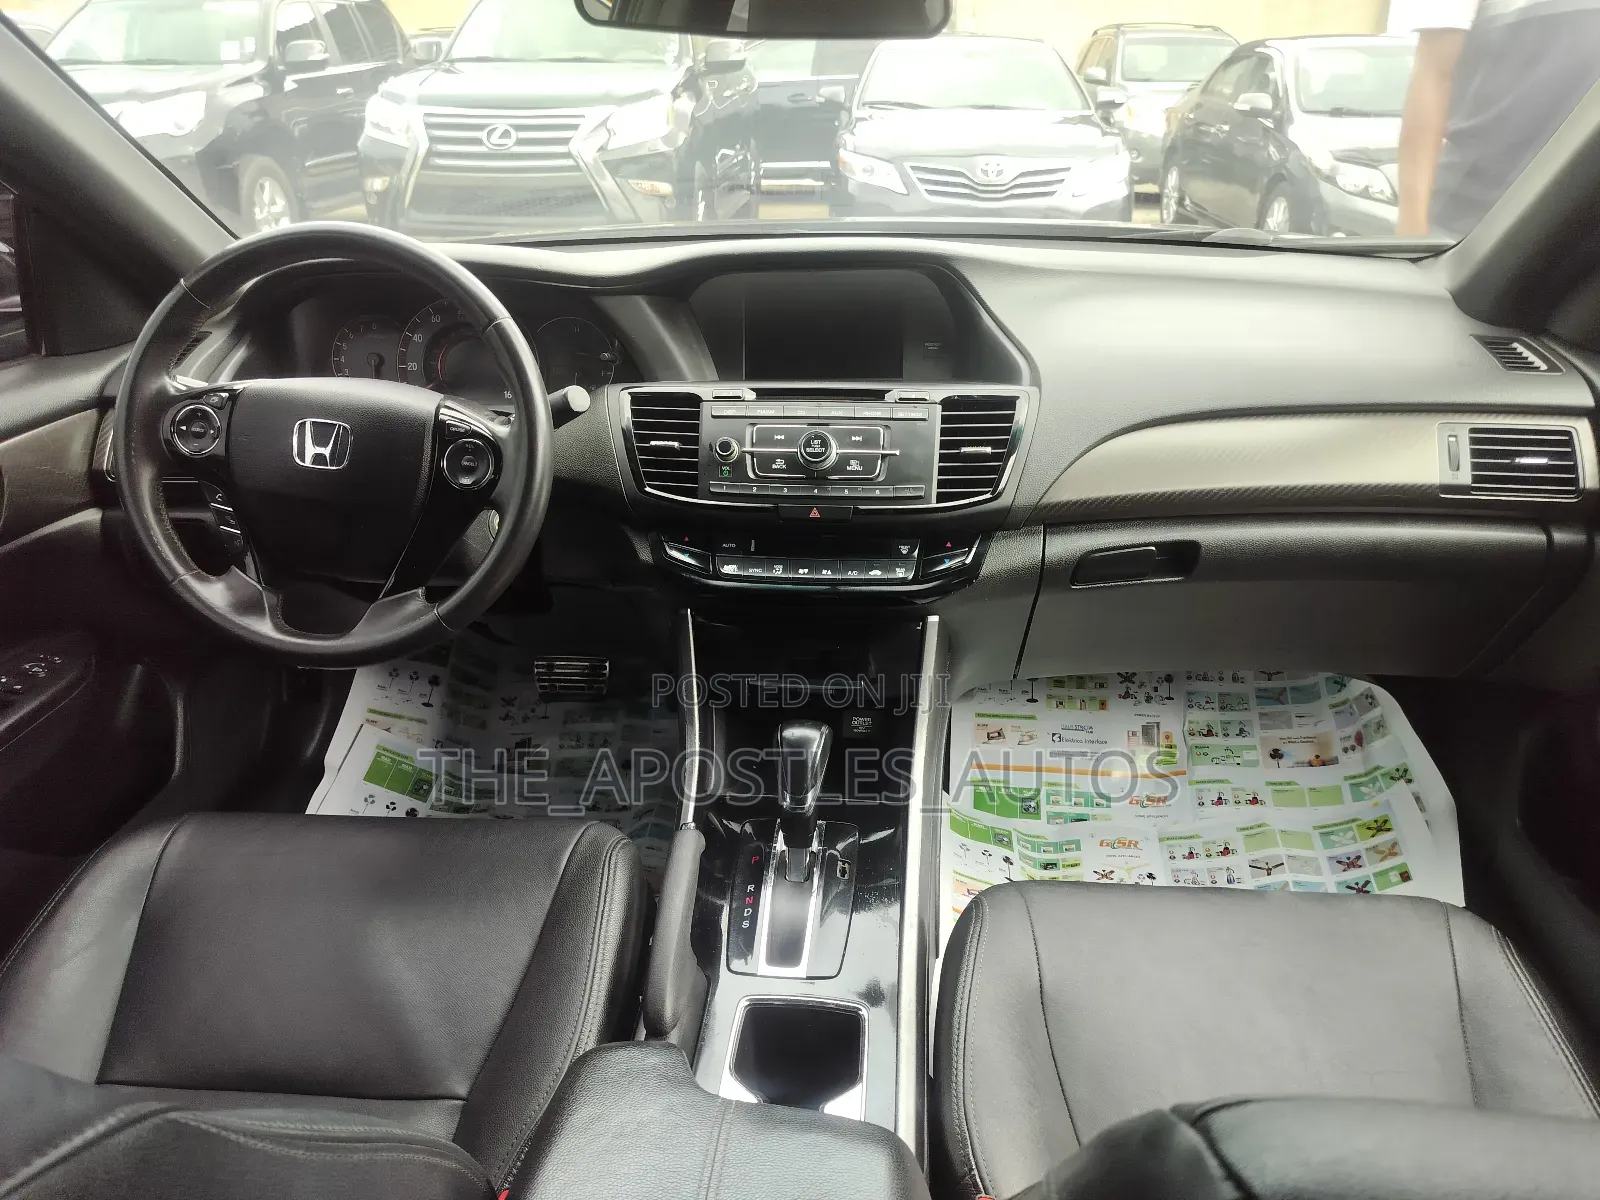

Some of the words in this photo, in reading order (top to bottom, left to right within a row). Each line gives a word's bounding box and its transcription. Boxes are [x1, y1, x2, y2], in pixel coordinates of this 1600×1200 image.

[431, 314, 441, 323] 60
[412, 333, 423, 343] 40
[342, 342, 348, 350] 5
[340, 355, 345, 363] 4
[407, 362, 418, 371] 20
[751, 855, 760, 865] P
[746, 884, 755, 893] R
[745, 895, 754, 905] N
[743, 907, 753, 917] D
[741, 920, 750, 929] S
